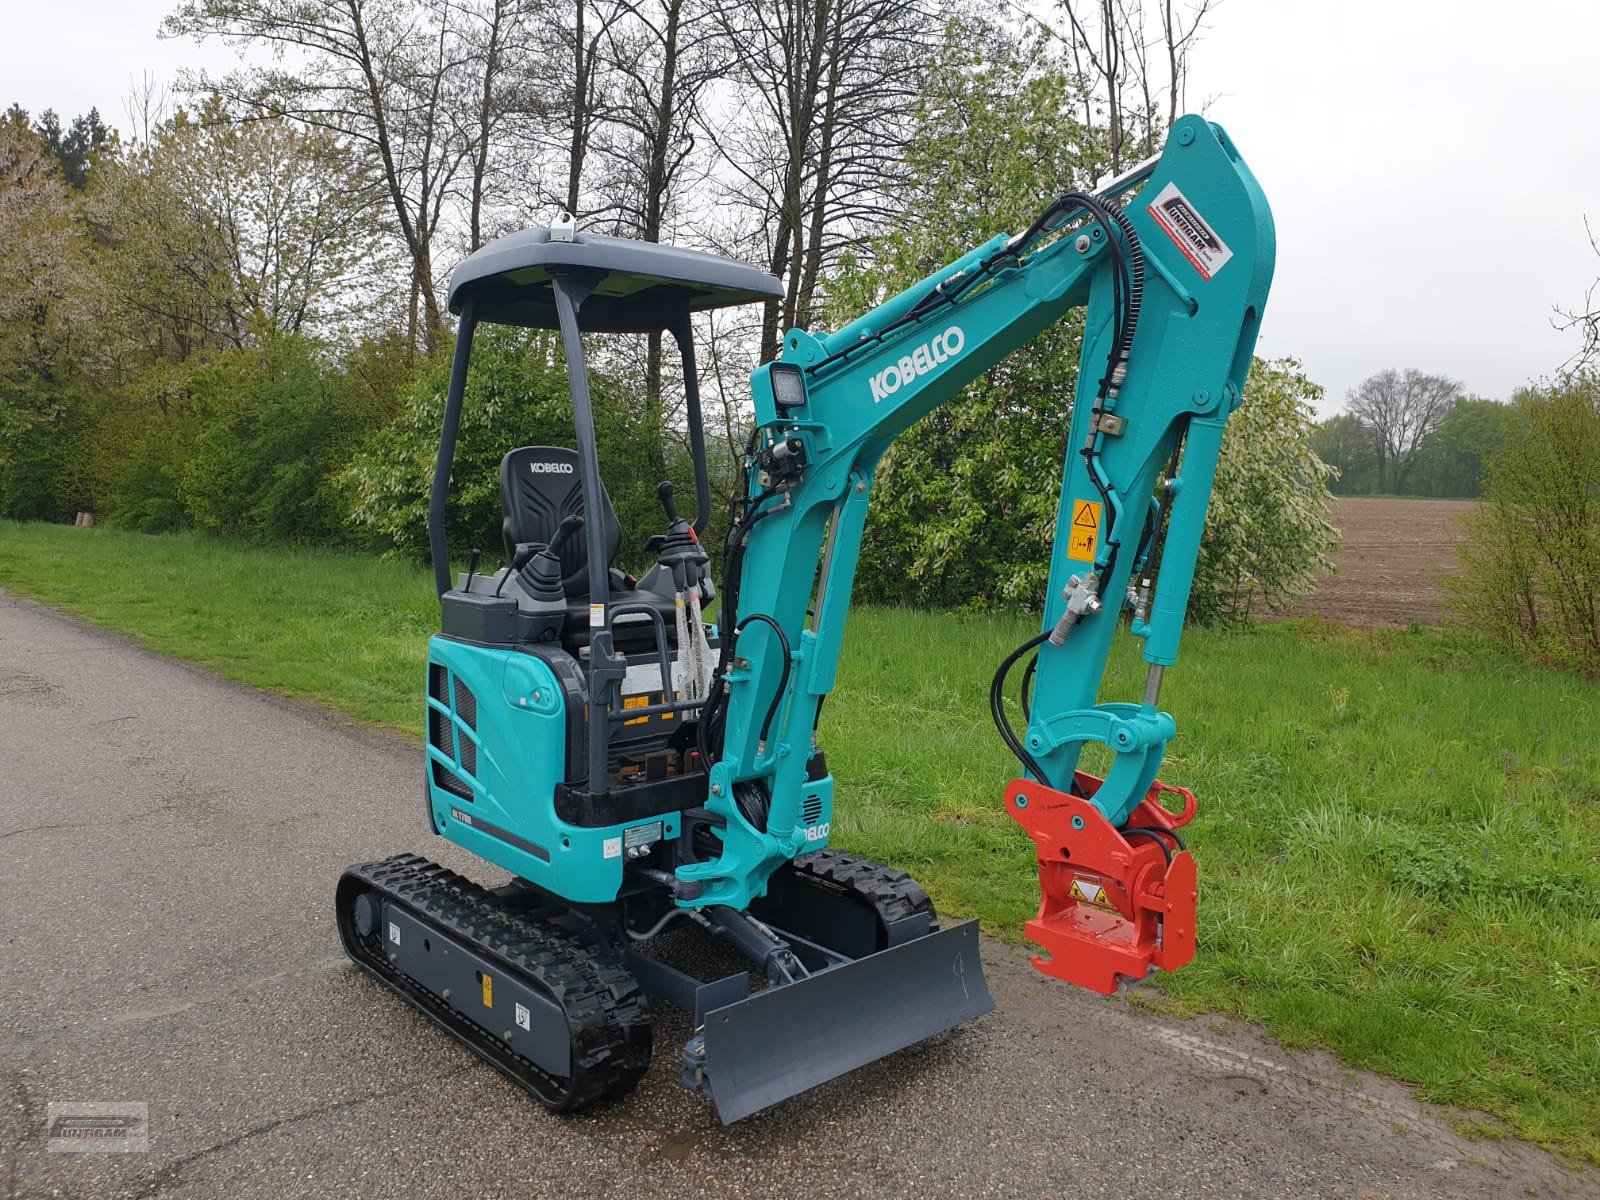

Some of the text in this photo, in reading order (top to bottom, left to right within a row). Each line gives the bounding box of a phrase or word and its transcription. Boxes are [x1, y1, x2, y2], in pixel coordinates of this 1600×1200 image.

[1168, 207, 1206, 250] UNTIGAM
[868, 326, 965, 404] KOBELCO
[530, 462, 574, 474] KOBELCO
